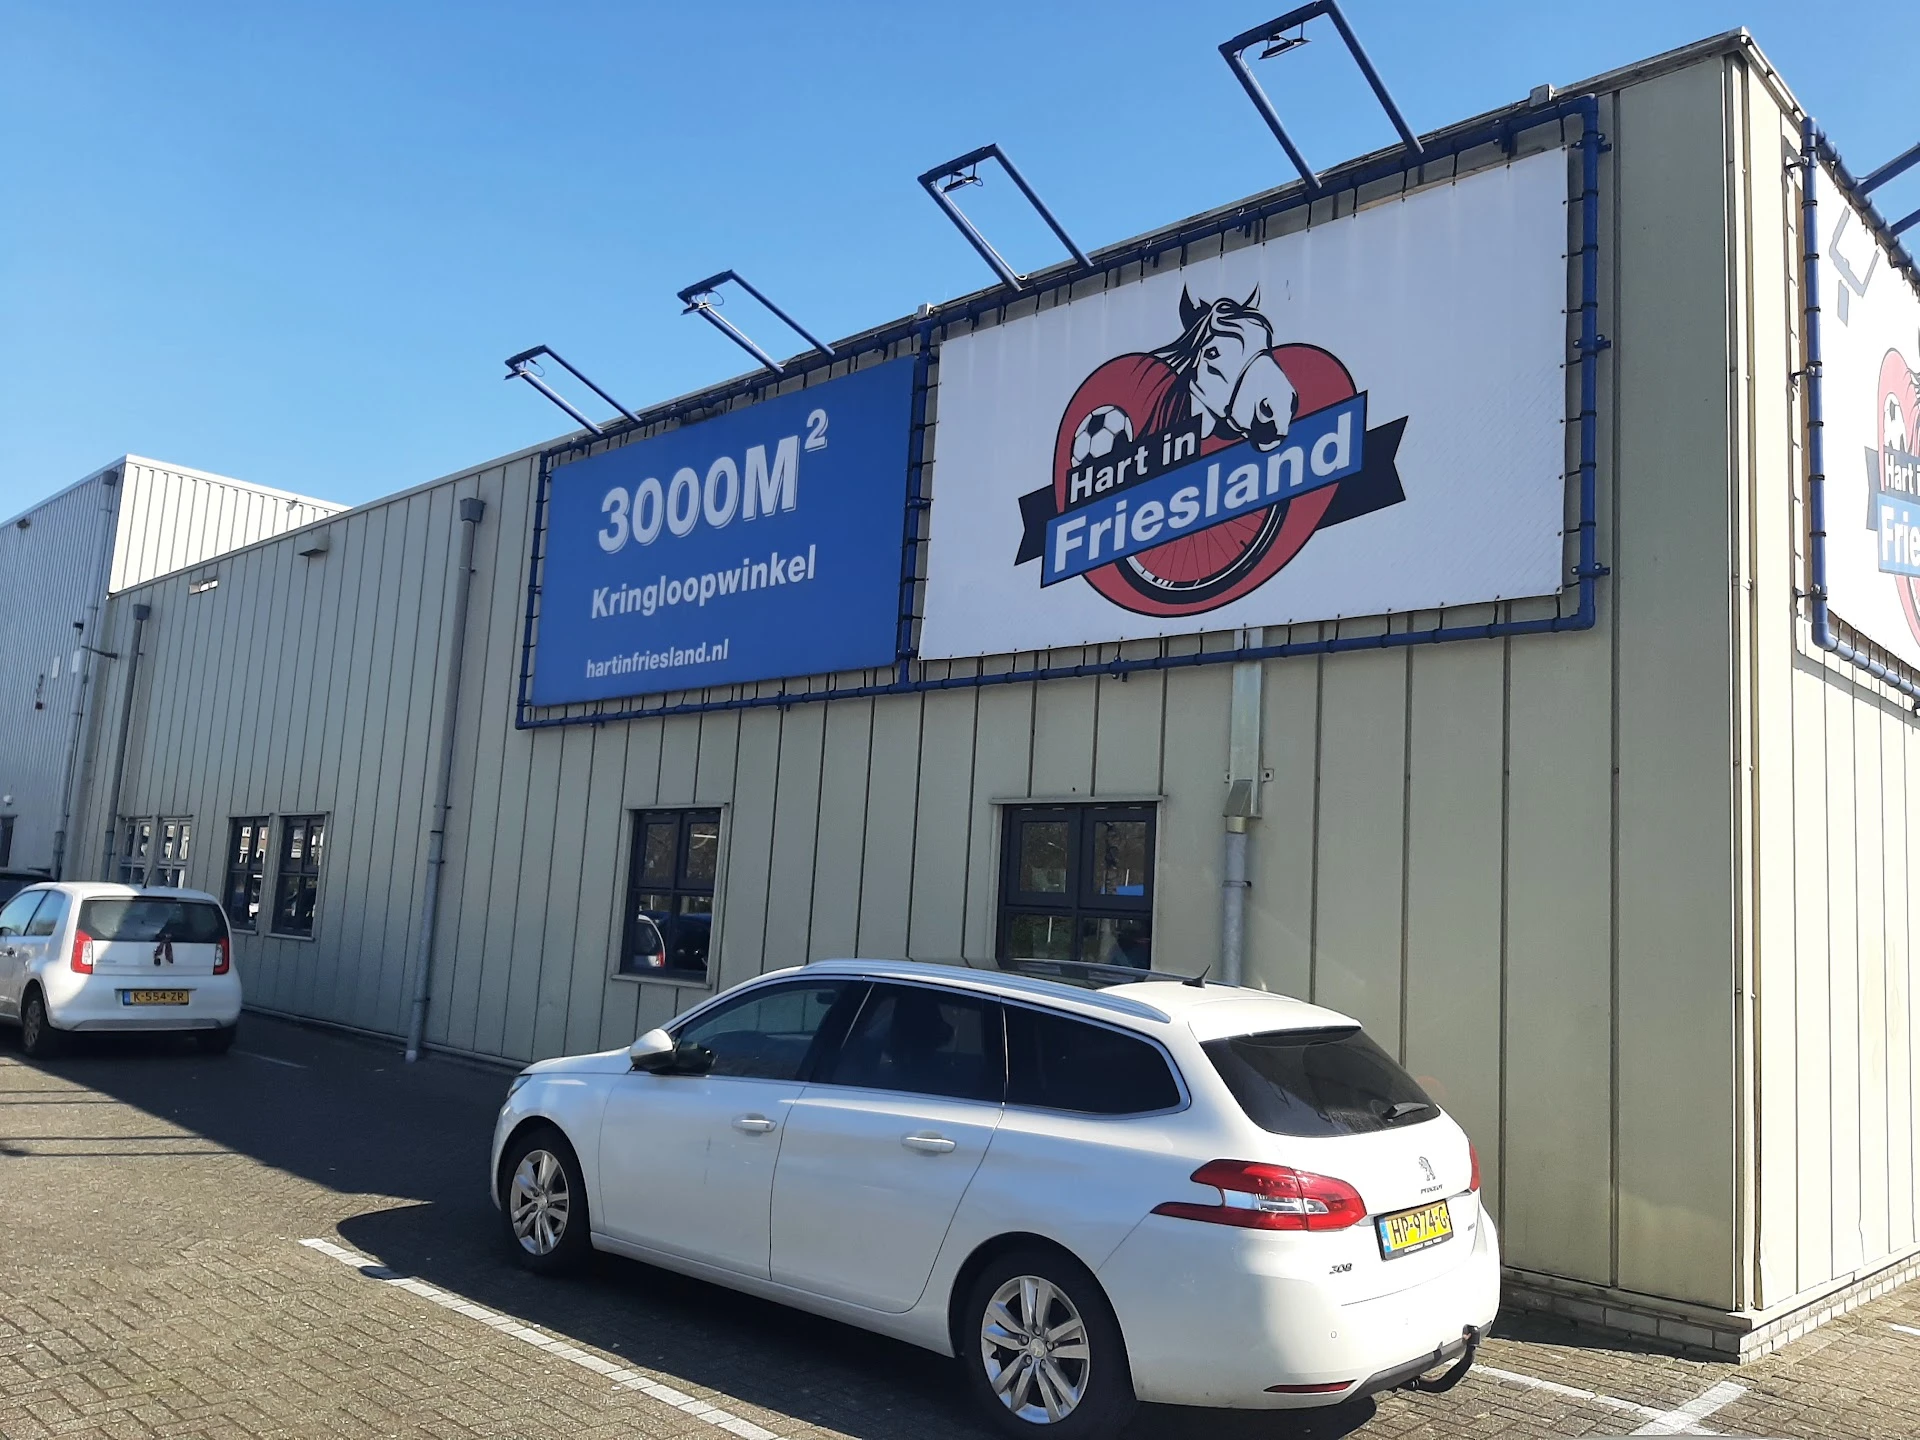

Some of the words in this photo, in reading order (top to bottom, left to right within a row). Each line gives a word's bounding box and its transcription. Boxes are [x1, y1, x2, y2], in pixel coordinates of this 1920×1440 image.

[1069, 446, 1148, 503] Hart
[1162, 428, 1196, 466] in
[1884, 452, 1914, 495] Hart
[1054, 411, 1353, 573] Friesland
[590, 544, 817, 619] Kringloopwinkel
[586, 638, 729, 679] hartinfriesland.nl
[133, 991, 184, 1002] K-554-ZR
[1390, 1205, 1449, 1245] HP-974-G
[1329, 1262, 1353, 1275] 308
